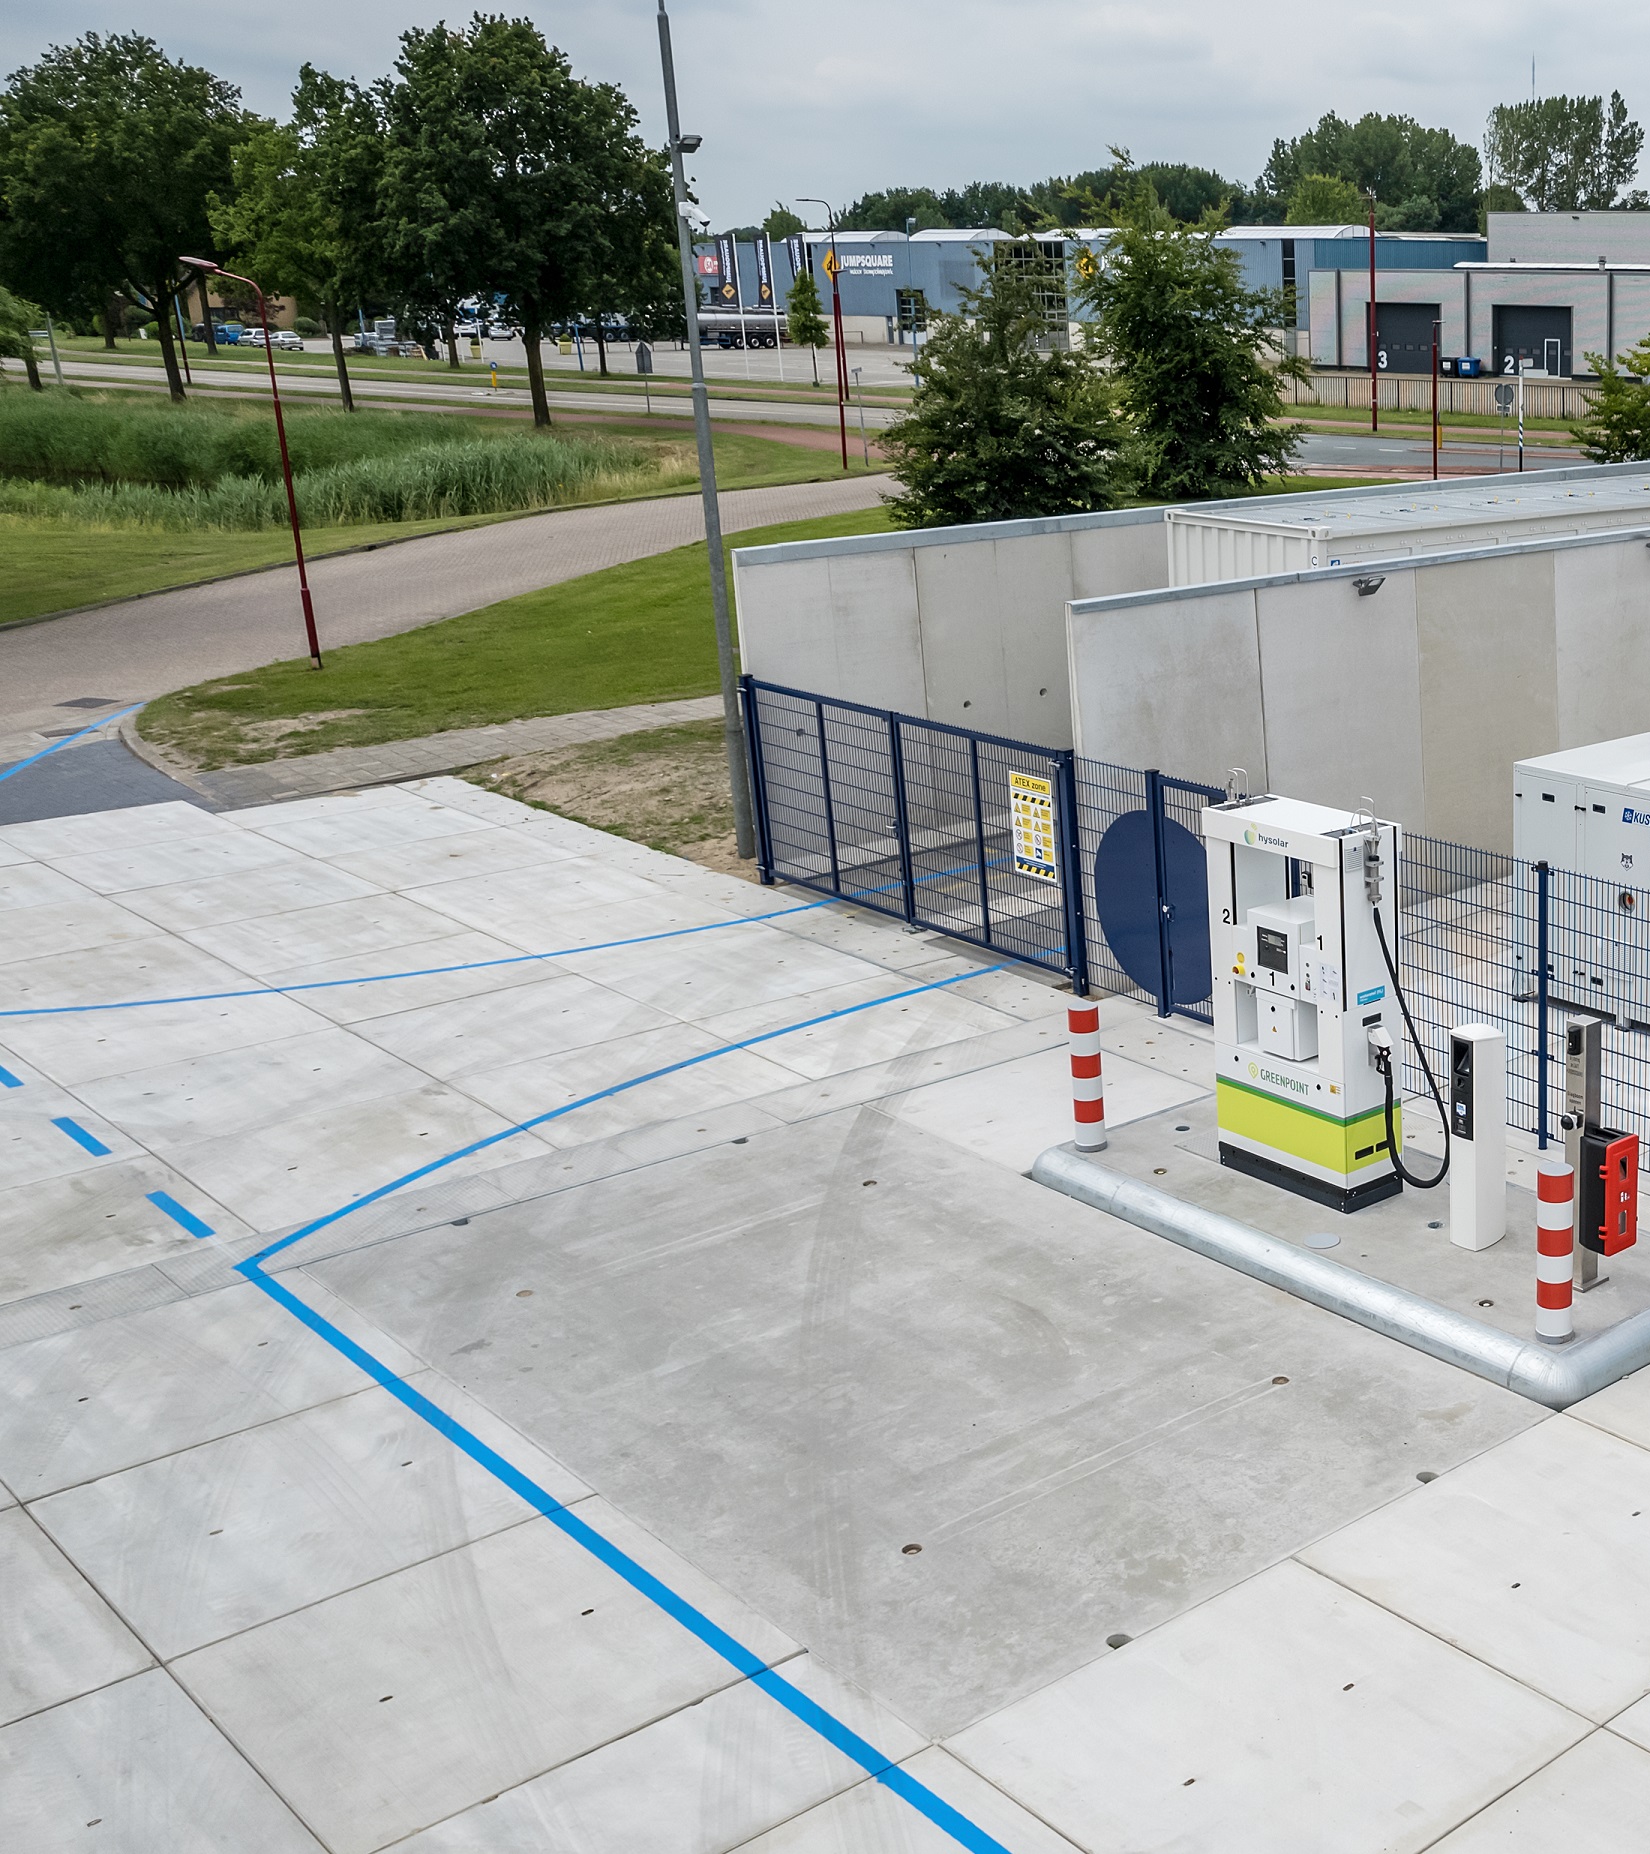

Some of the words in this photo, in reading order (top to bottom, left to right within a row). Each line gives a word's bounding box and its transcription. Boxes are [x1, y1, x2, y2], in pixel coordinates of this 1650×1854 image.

[841, 255, 893, 269] JUMPSQUARE
[1377, 350, 1388, 369] 3
[1503, 355, 1515, 374] 2
[1015, 777, 1030, 787] ATEX
[1032, 782, 1046, 792] zone
[1258, 833, 1289, 848] hysolar
[1222, 908, 1231, 925] 2
[1317, 935, 1323, 950] 1
[1269, 971, 1275, 986] 1
[1260, 1069, 1310, 1096] GREENPOINT
